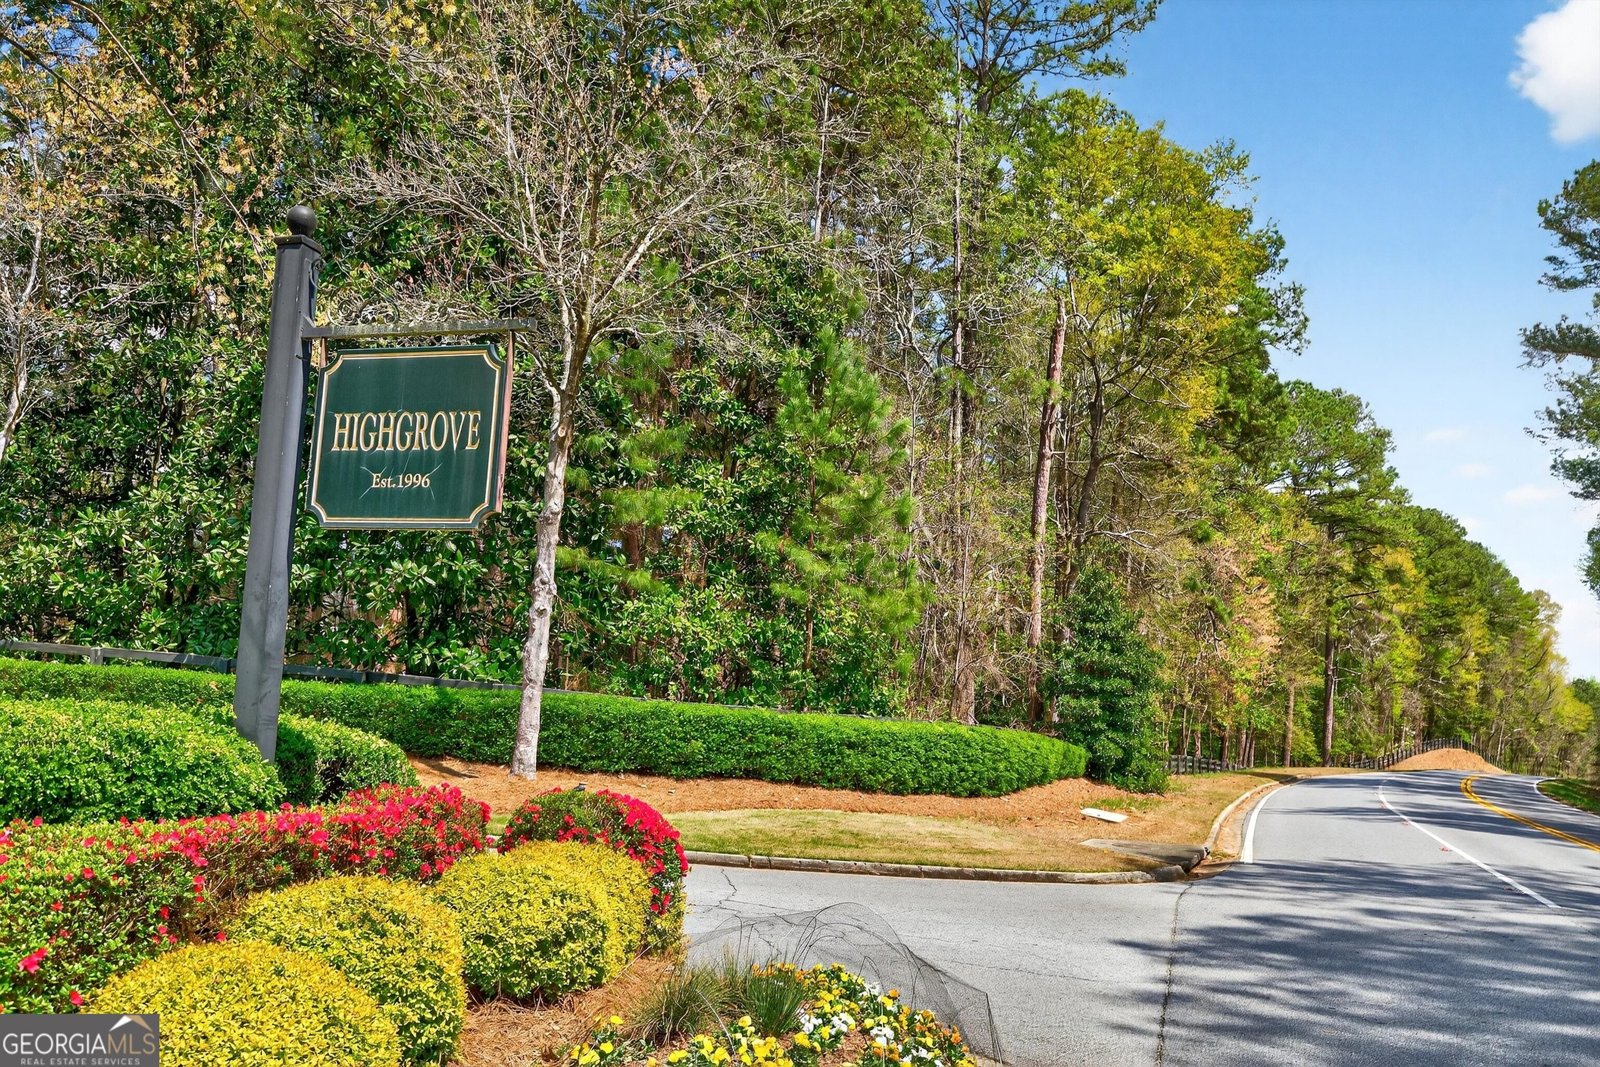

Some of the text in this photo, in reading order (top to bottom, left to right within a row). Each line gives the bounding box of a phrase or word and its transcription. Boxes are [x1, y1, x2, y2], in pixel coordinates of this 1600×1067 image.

[331, 411, 481, 451] HIGHGROVE
[371, 473, 431, 489] Est. 1996
